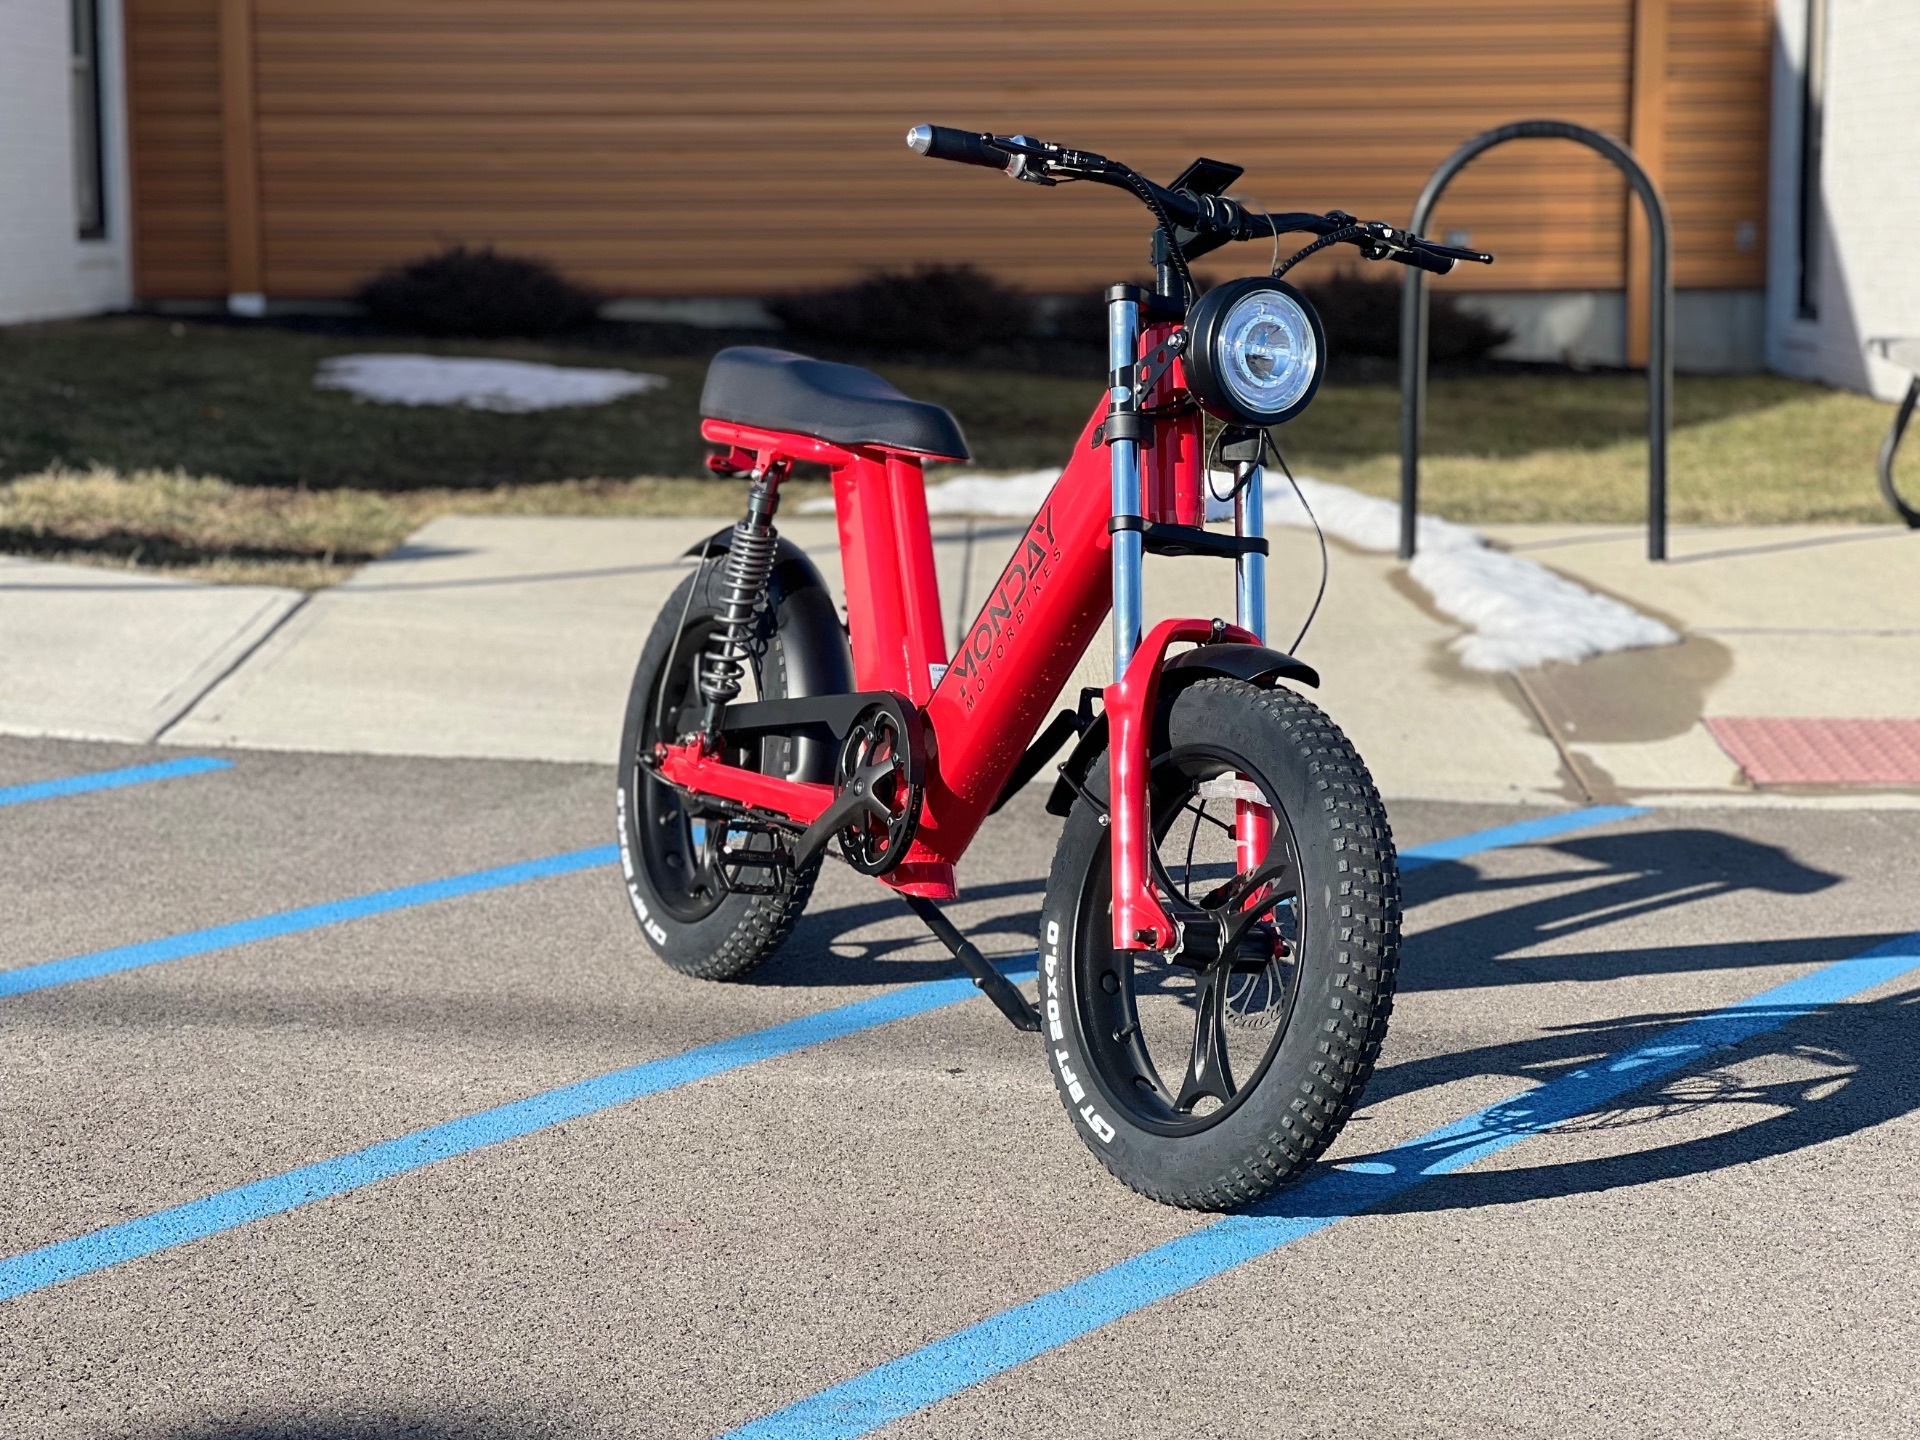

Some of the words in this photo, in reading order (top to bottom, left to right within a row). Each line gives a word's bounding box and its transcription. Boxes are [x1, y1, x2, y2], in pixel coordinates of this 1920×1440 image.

[953, 504, 1055, 697] MONDAY
[966, 548, 1061, 712] MOTORBIKES
[1055, 1049, 1086, 1103] BFT
[1080, 1103, 1116, 1144] CST
